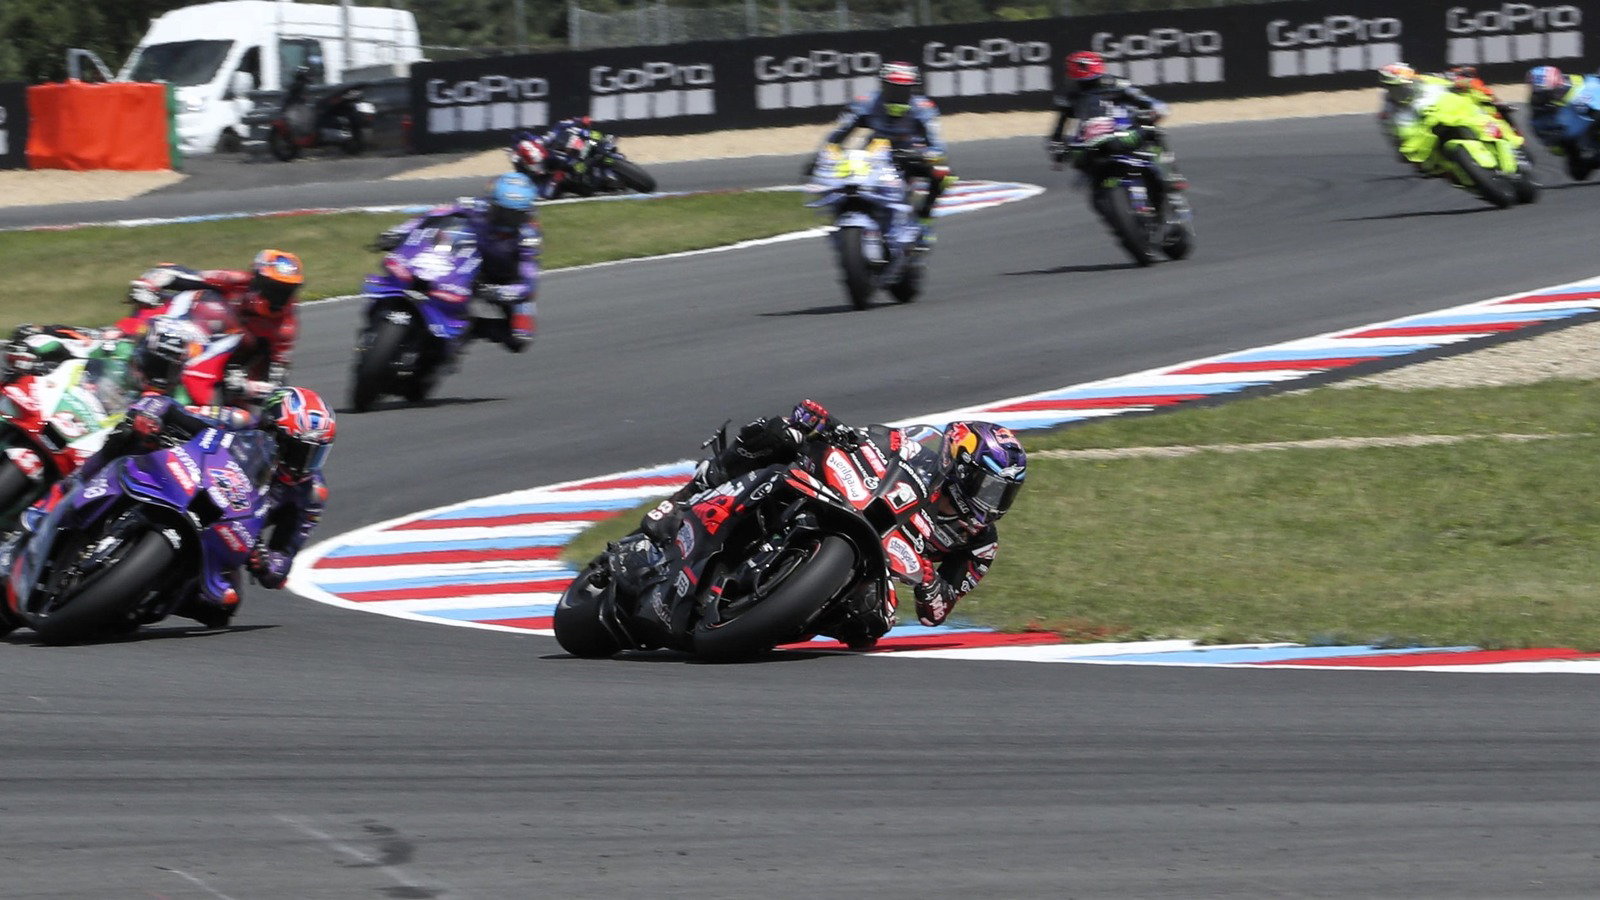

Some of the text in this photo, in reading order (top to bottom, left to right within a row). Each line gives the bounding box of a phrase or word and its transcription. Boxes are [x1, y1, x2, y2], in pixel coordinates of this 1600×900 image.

[1267, 15, 1402, 45] GoPro
[1447, 3, 1582, 32] GoPro
[923, 38, 1051, 68] GoPro
[1092, 28, 1222, 57] GoPro
[590, 62, 714, 92] GoPro
[754, 50, 881, 80] GoPro
[426, 75, 548, 104] GoPro
